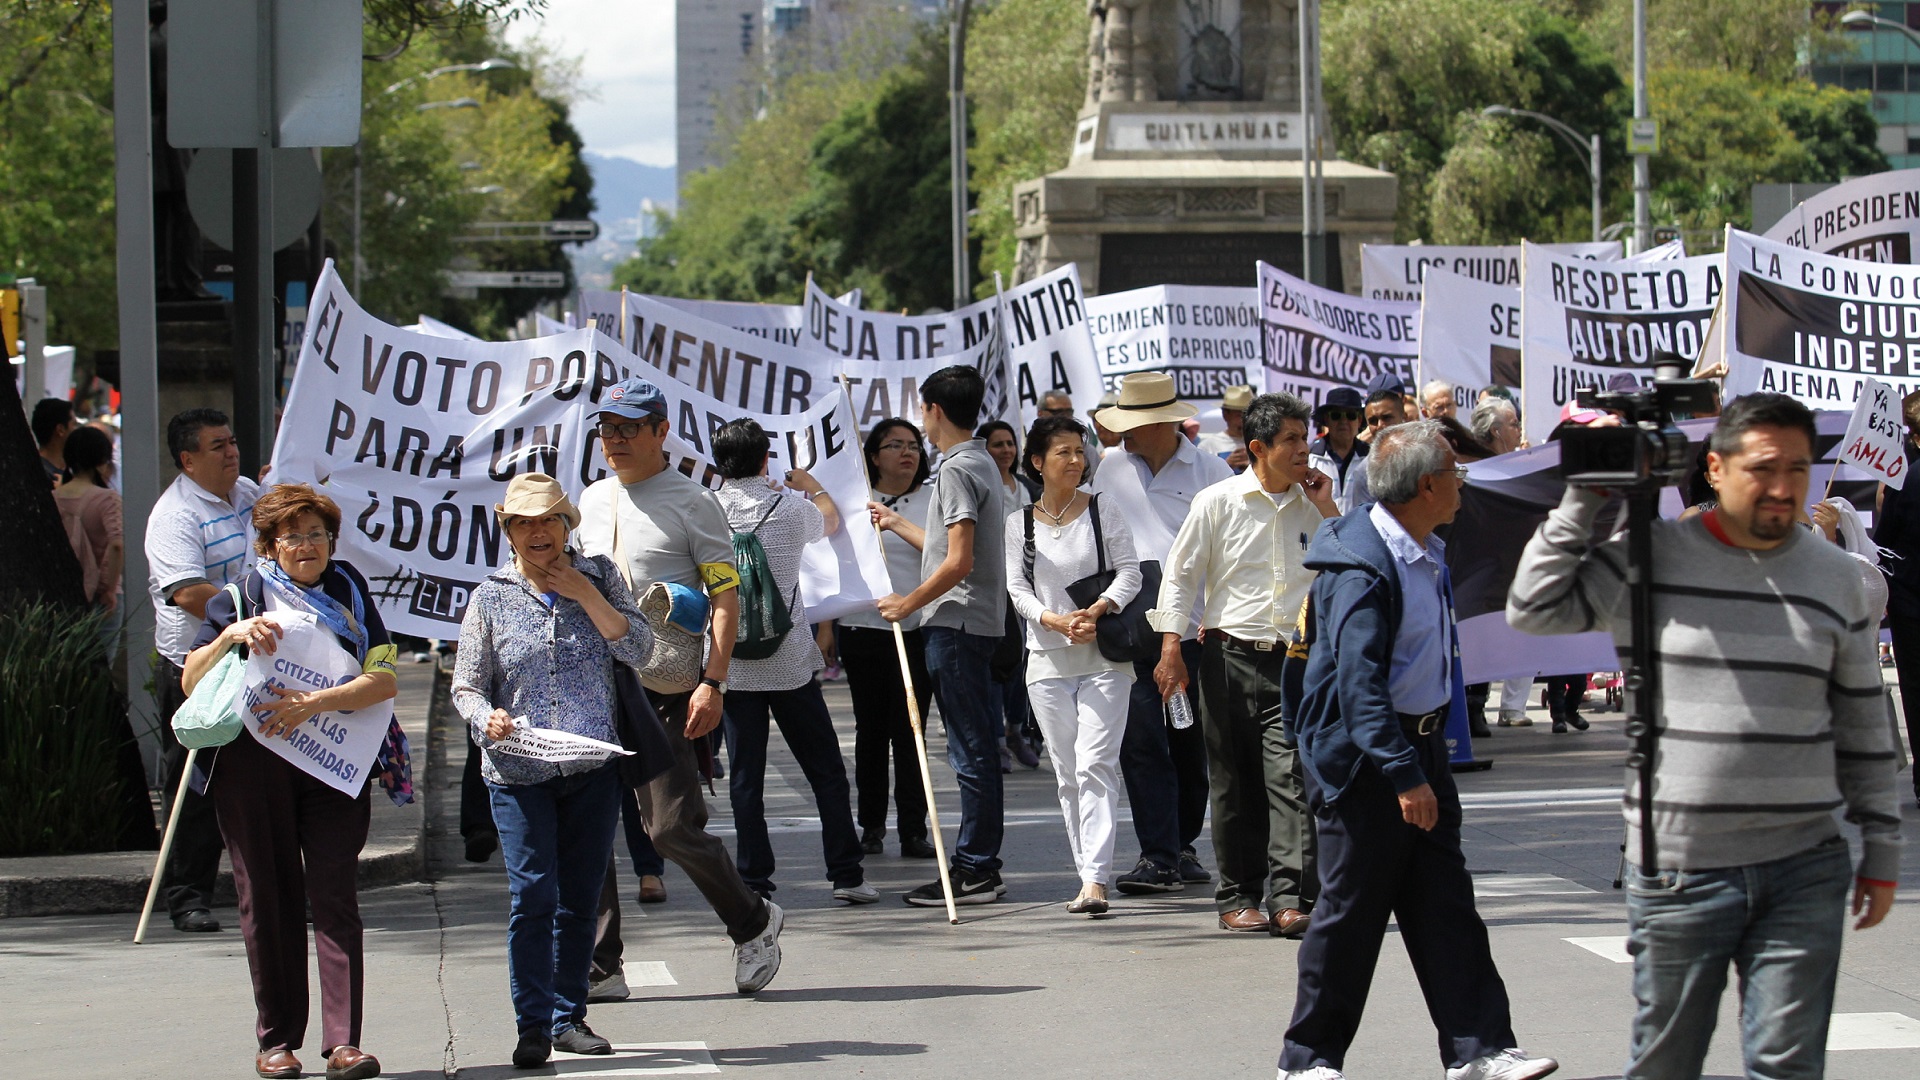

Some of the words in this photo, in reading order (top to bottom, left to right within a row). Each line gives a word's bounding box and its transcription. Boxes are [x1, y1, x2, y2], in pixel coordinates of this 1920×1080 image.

[1145, 121, 1288, 141] CUITLAHUAC
[1752, 247, 1782, 279] LA
[1552, 262, 1688, 310] RESPETO
[811, 294, 879, 361] DEJA
[962, 277, 1081, 351] MNTIR
[1386, 314, 1416, 341] DE
[313, 291, 343, 375] EL
[361, 334, 501, 415] VOTO
[632, 314, 811, 415] MENTIR
[1107, 344, 1129, 365] ES
[1137, 339, 1162, 361] UN
[1794, 331, 1920, 376] INDEPE
[1762, 367, 1841, 401] AJENA
[1873, 389, 1888, 413] YA
[325, 399, 464, 480] PARA
[488, 424, 562, 482] UN
[1847, 436, 1903, 478] AMLO
[320, 716, 348, 744] LAS
[286, 728, 359, 783] ARMADAS!
